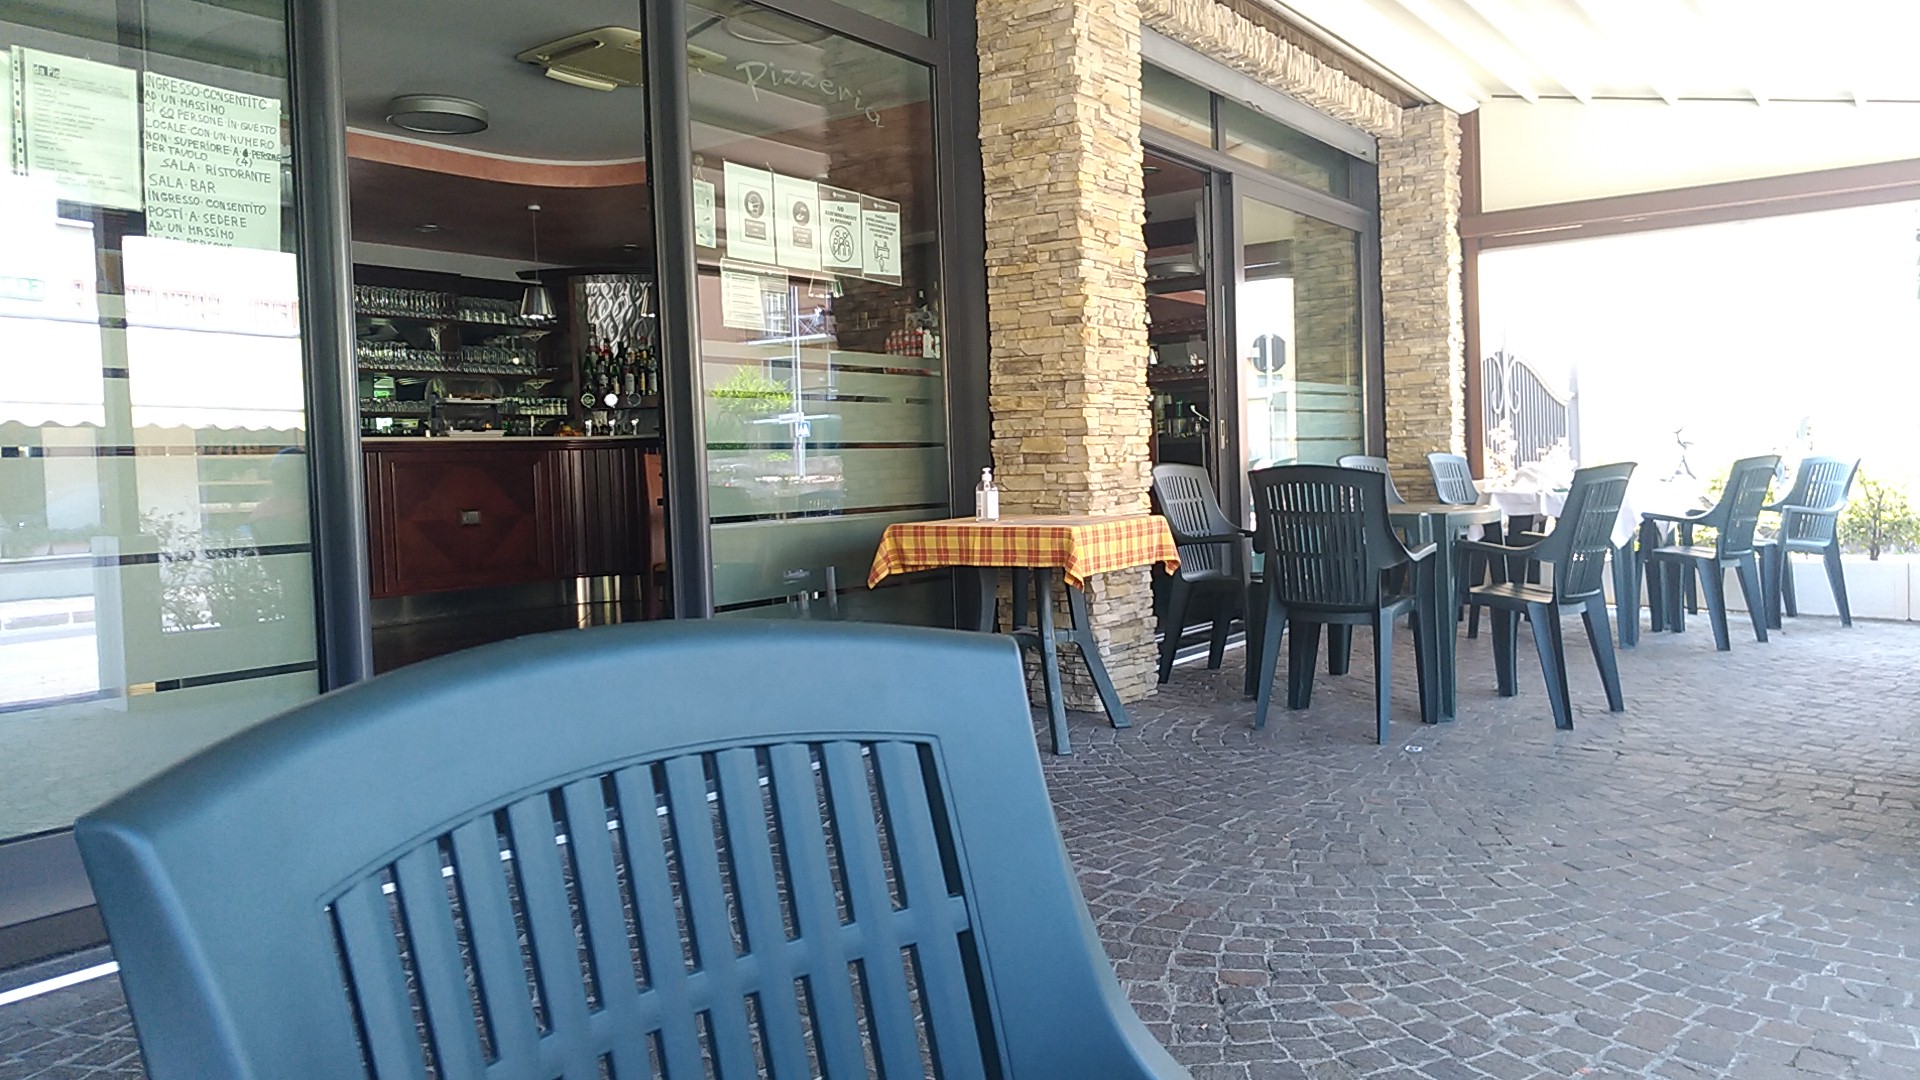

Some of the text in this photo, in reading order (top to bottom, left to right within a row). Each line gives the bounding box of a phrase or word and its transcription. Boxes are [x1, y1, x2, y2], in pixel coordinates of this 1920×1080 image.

[144, 89, 225, 115] AD UN MASSIMO
[145, 74, 200, 97] INGRESSO
[203, 88, 268, 110] CONSENTITO
[735, 61, 884, 128] Pizzeria
[145, 102, 155, 112] DI
[177, 109, 224, 127] PERSONE
[227, 119, 237, 130] IN
[240, 122, 277, 135] QUESTO
[145, 118, 275, 150] LOCALE CON UN NUMERO
[145, 130, 167, 143] NON
[174, 136, 230, 154] SUPERIORE
[233, 146, 240, 157] A
[145, 141, 208, 161] PER TAVOLO
[149, 173, 217, 194] SALA BAR
[160, 157, 271, 184] SALA RISTORANTE
[147, 187, 267, 216] INGRESSO CONSENTITO
[148, 205, 248, 228] POSTI A SEDERE
[148, 219, 163, 231] AD
[167, 222, 183, 233] UN
[188, 225, 235, 240] MASSIMO
